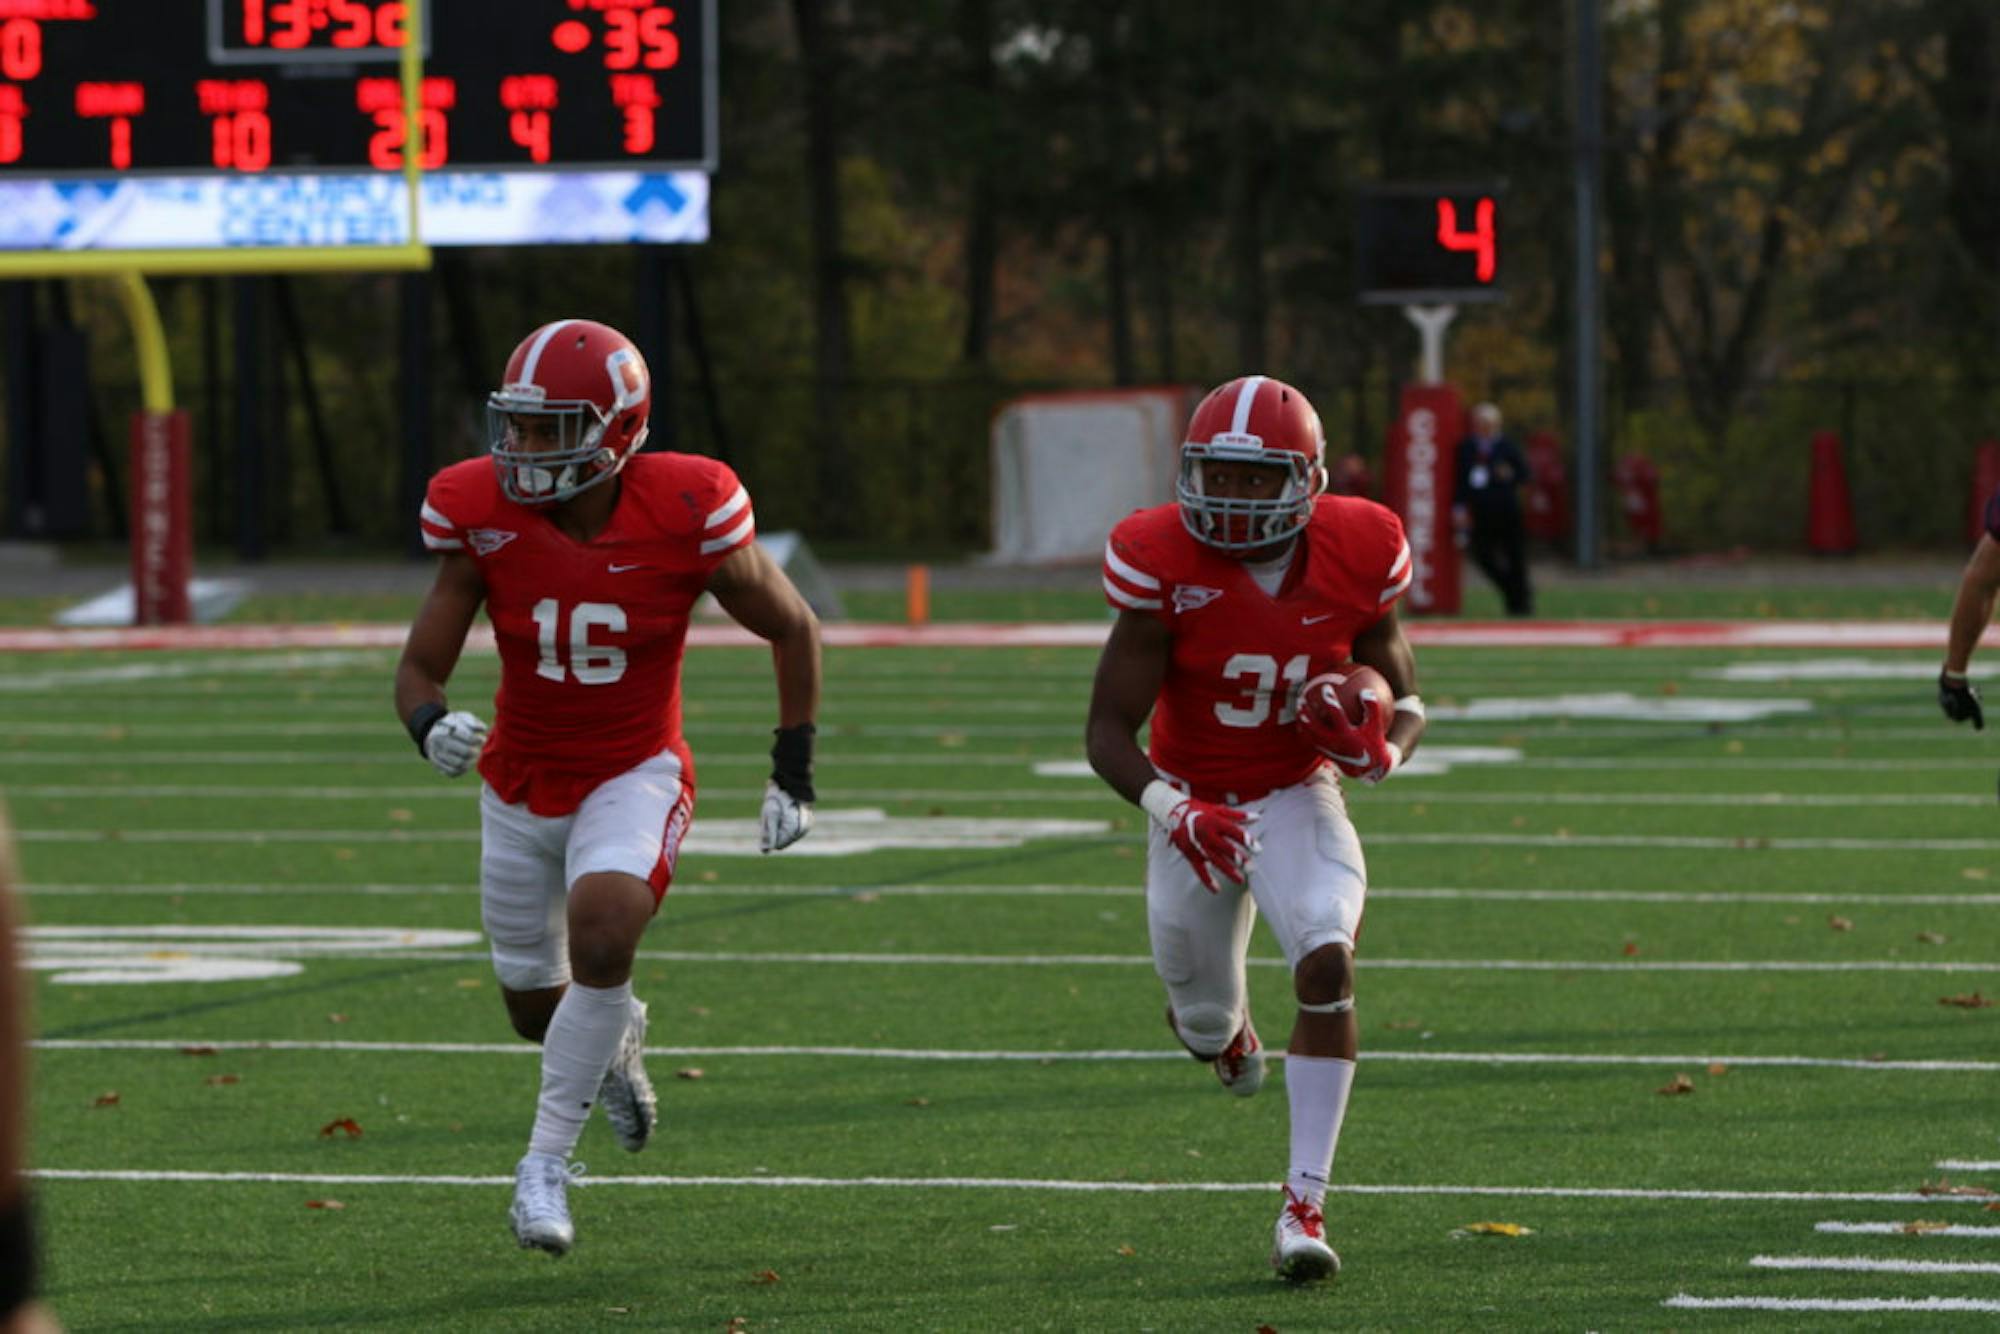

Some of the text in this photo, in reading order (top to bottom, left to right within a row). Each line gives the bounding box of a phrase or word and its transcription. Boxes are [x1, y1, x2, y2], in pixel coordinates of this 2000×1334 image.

[603, 6, 679, 70] 35
[110, 116, 131, 170] 1
[213, 110, 271, 172] 10
[369, 108, 446, 170] 20
[510, 110, 549, 164] 4
[624, 103, 654, 154] 3
[1437, 196, 1495, 284] 4
[531, 598, 628, 685] 16
[1213, 653, 1310, 727] 31
